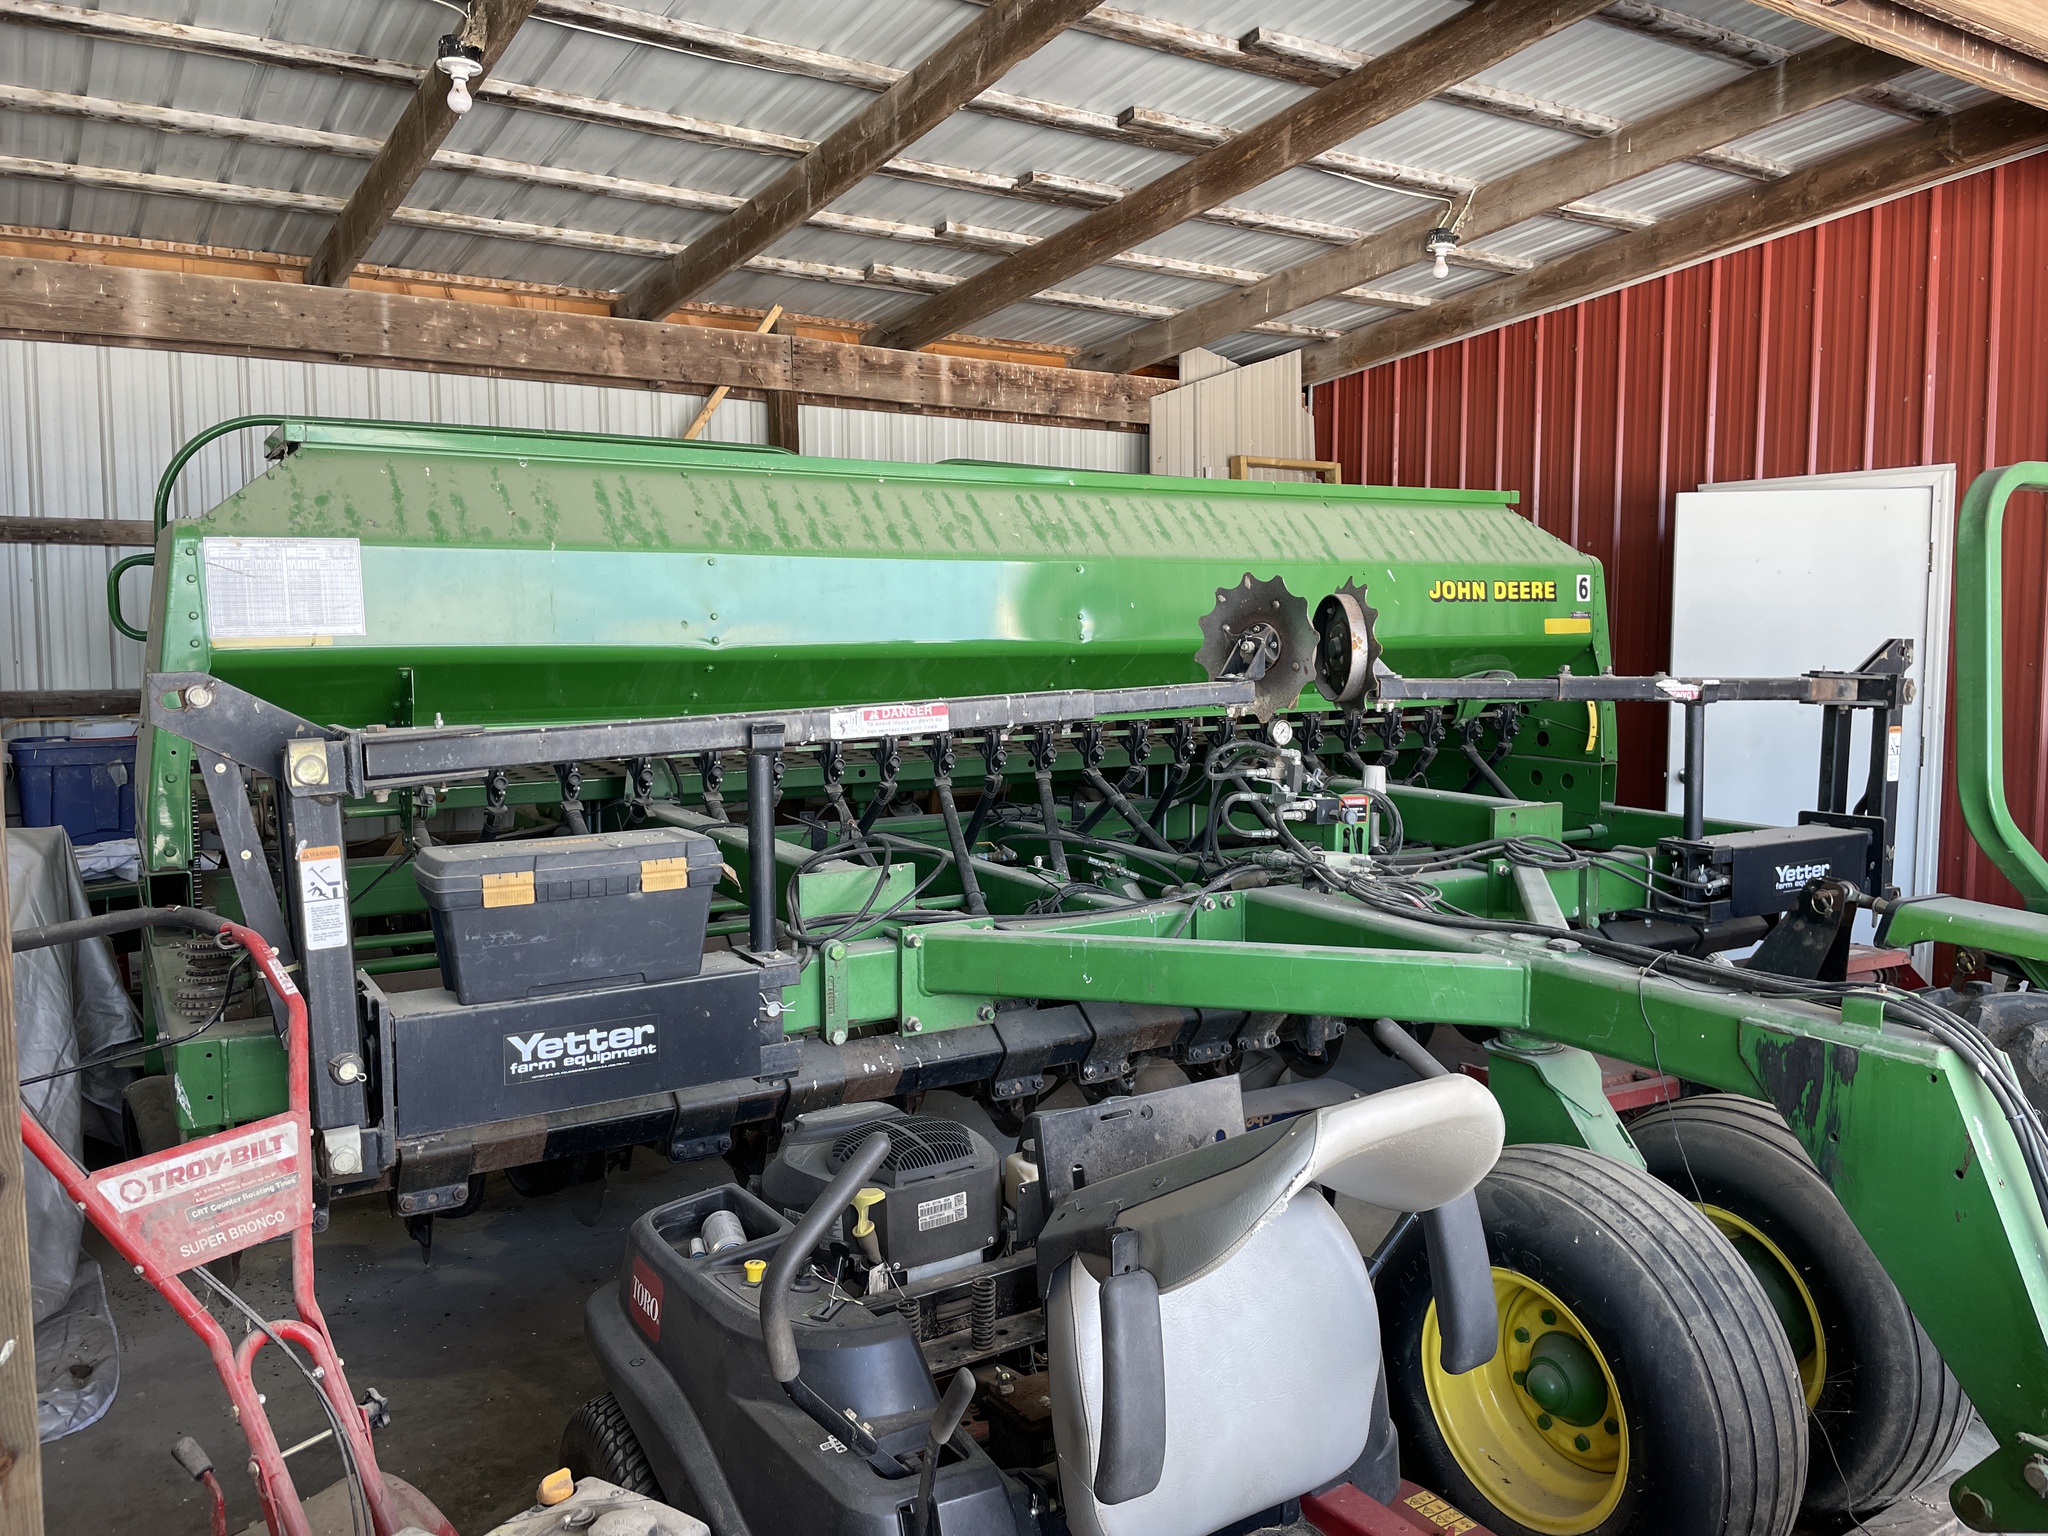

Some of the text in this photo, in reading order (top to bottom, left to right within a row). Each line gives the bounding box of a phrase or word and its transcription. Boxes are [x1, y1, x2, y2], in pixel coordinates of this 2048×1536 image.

[1429, 580, 1557, 602] JOHN DEERE
[1579, 577, 1588, 600] 6
[882, 706, 932, 718] DANGER
[893, 719, 910, 727] injury
[901, 724, 923, 732] electric
[310, 849, 339, 858] WARNING
[1775, 863, 1830, 882] Yetter
[1775, 882, 1793, 890] farm
[506, 1024, 655, 1062] Yetter
[510, 1059, 556, 1075] farm
[563, 1043, 657, 1066] equipment
[147, 1134, 285, 1193] TROY-BILT
[191, 1177, 297, 1218] CRT Counter Rotating Tines
[180, 1210, 285, 1258] SUPER BRONCO
[633, 1274, 659, 1322] TORO
